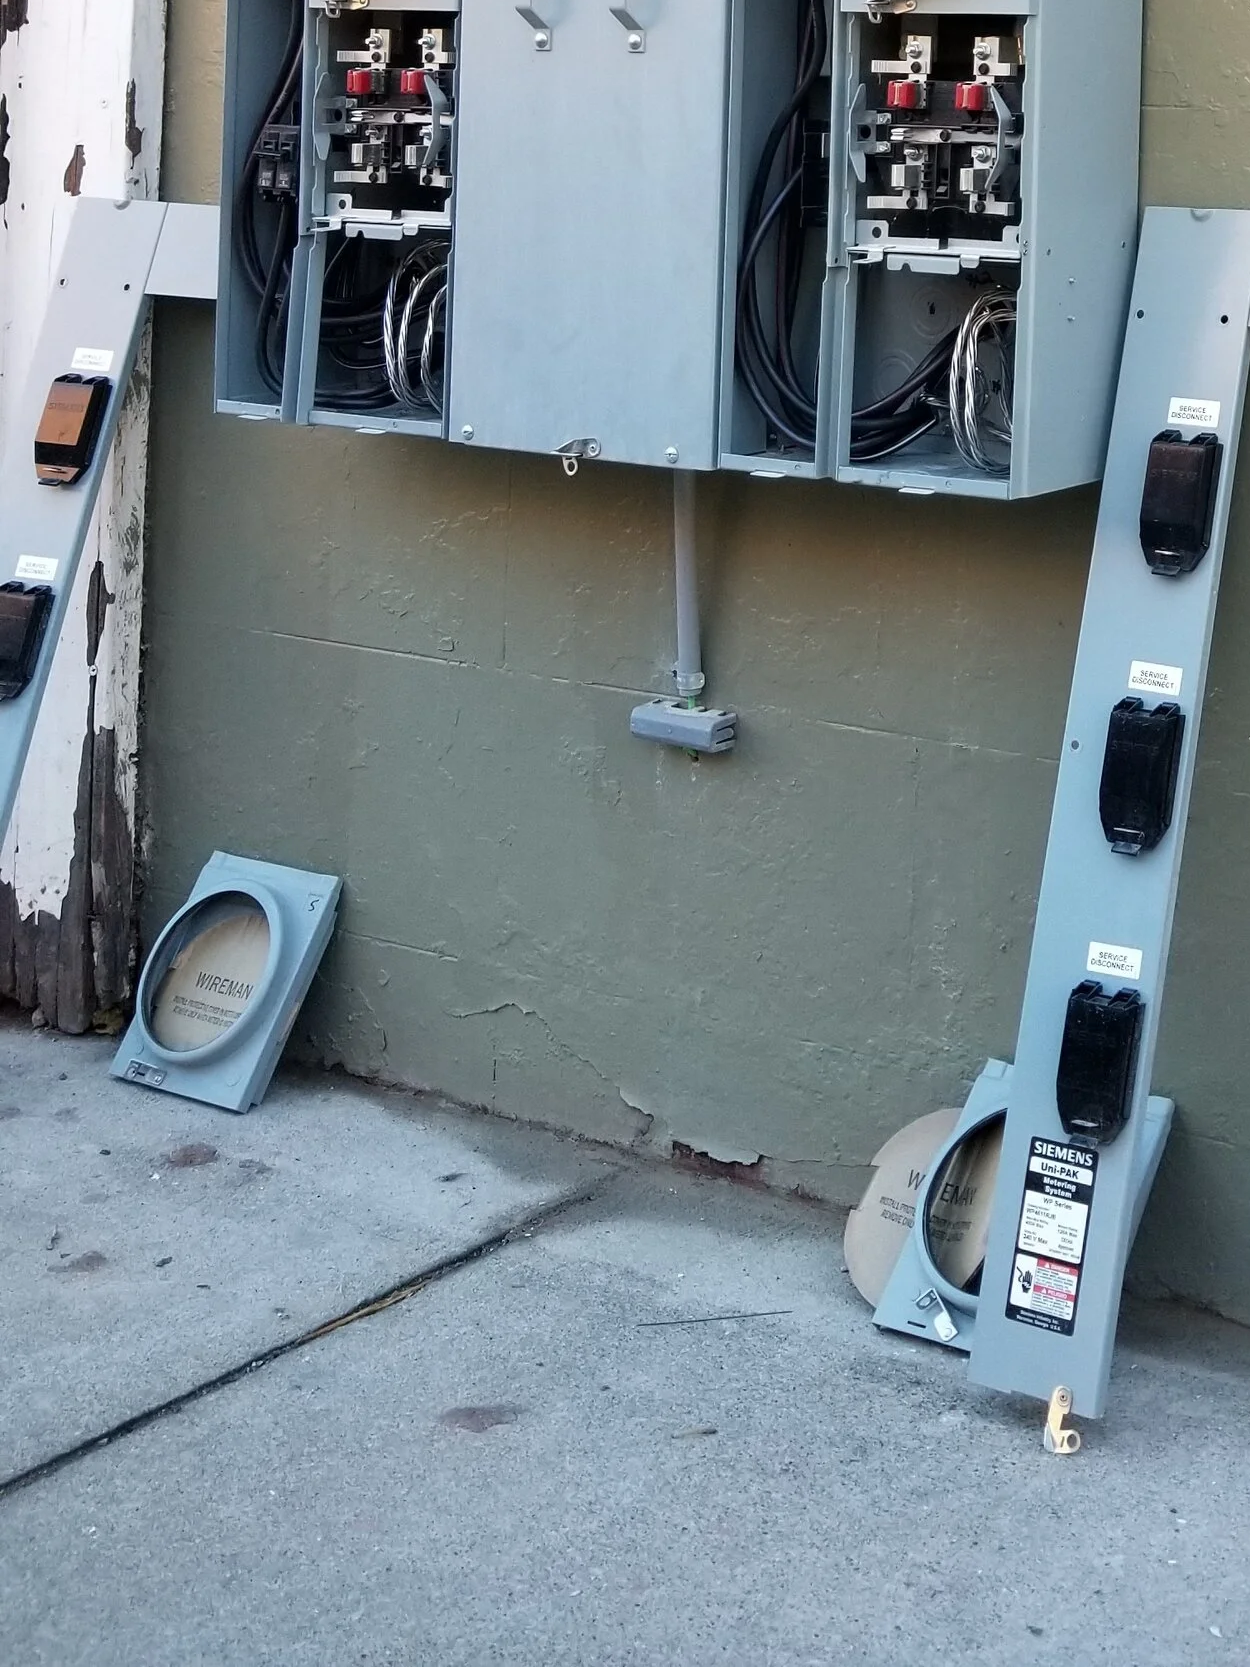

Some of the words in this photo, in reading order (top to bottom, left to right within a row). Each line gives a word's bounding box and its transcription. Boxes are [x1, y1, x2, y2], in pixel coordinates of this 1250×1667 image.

[1171, 411, 1212, 421] DISCONNECT
[1179, 405, 1207, 414] SERVICE
[1131, 675, 1175, 689] DISCONNECT
[1140, 669, 1168, 681] SERVICE
[1098, 951, 1128, 963] SERVICE
[1090, 957, 1134, 972] DISCONNECT
[195, 971, 254, 1000] WIREMAN
[1033, 1141, 1094, 1167] SIEMENS
[1040, 1161, 1080, 1180] Uni-PAK
[1043, 1176, 1077, 1193] Metering
[1044, 1185, 1072, 1199] System
